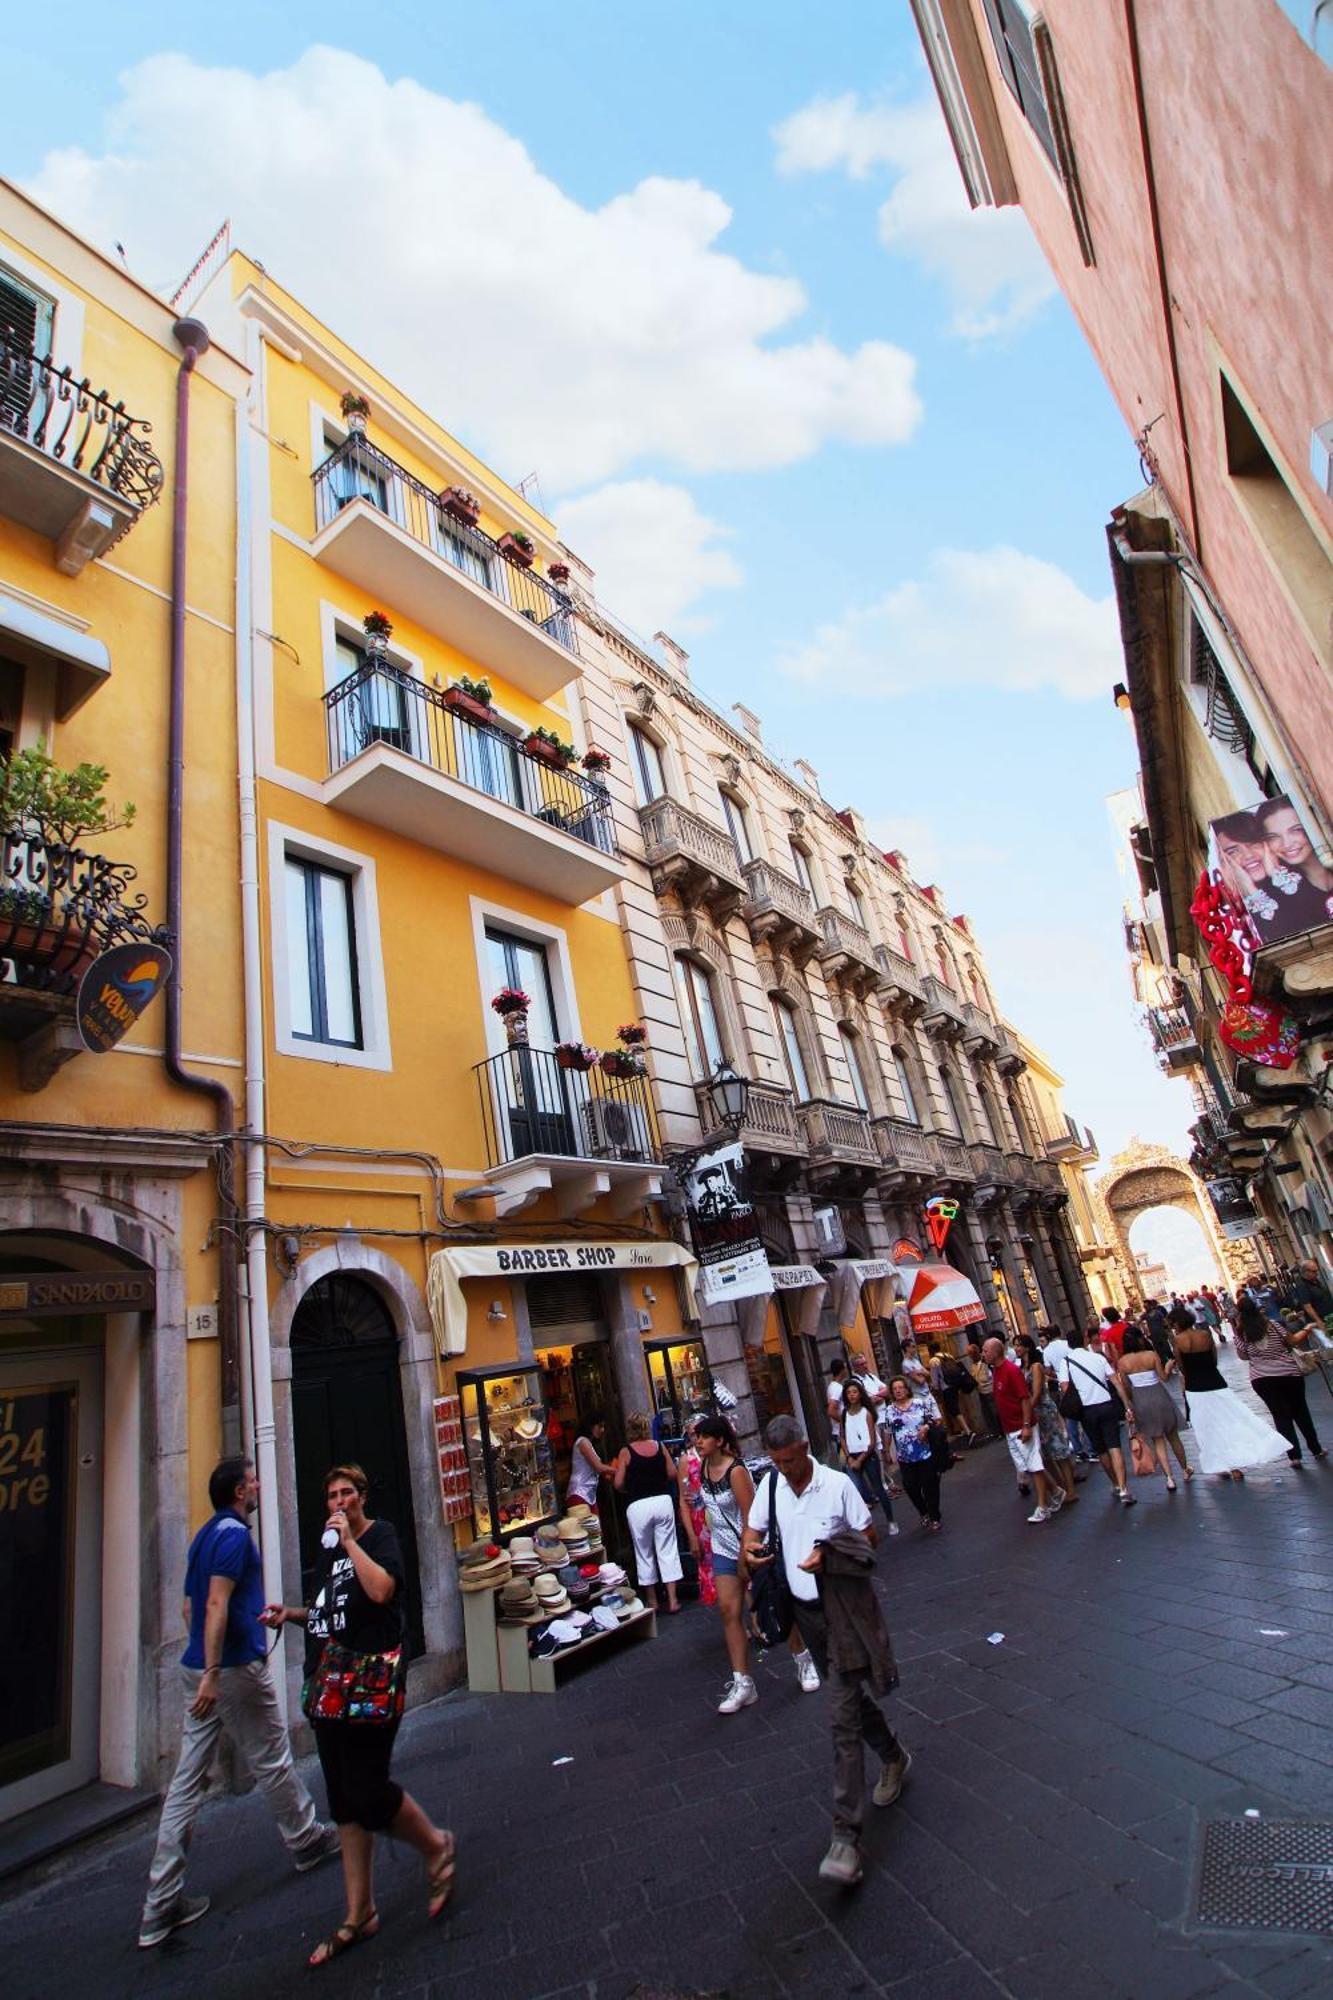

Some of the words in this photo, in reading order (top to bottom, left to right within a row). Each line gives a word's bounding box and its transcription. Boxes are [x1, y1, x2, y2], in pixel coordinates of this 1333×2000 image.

[813, 1207, 834, 1242] T
[497, 1248, 571, 1271] BARBER
[578, 1247, 616, 1266] SHOP
[34, 1281, 144, 1305] SANPAOLO
[196, 1314, 212, 1330] 15
